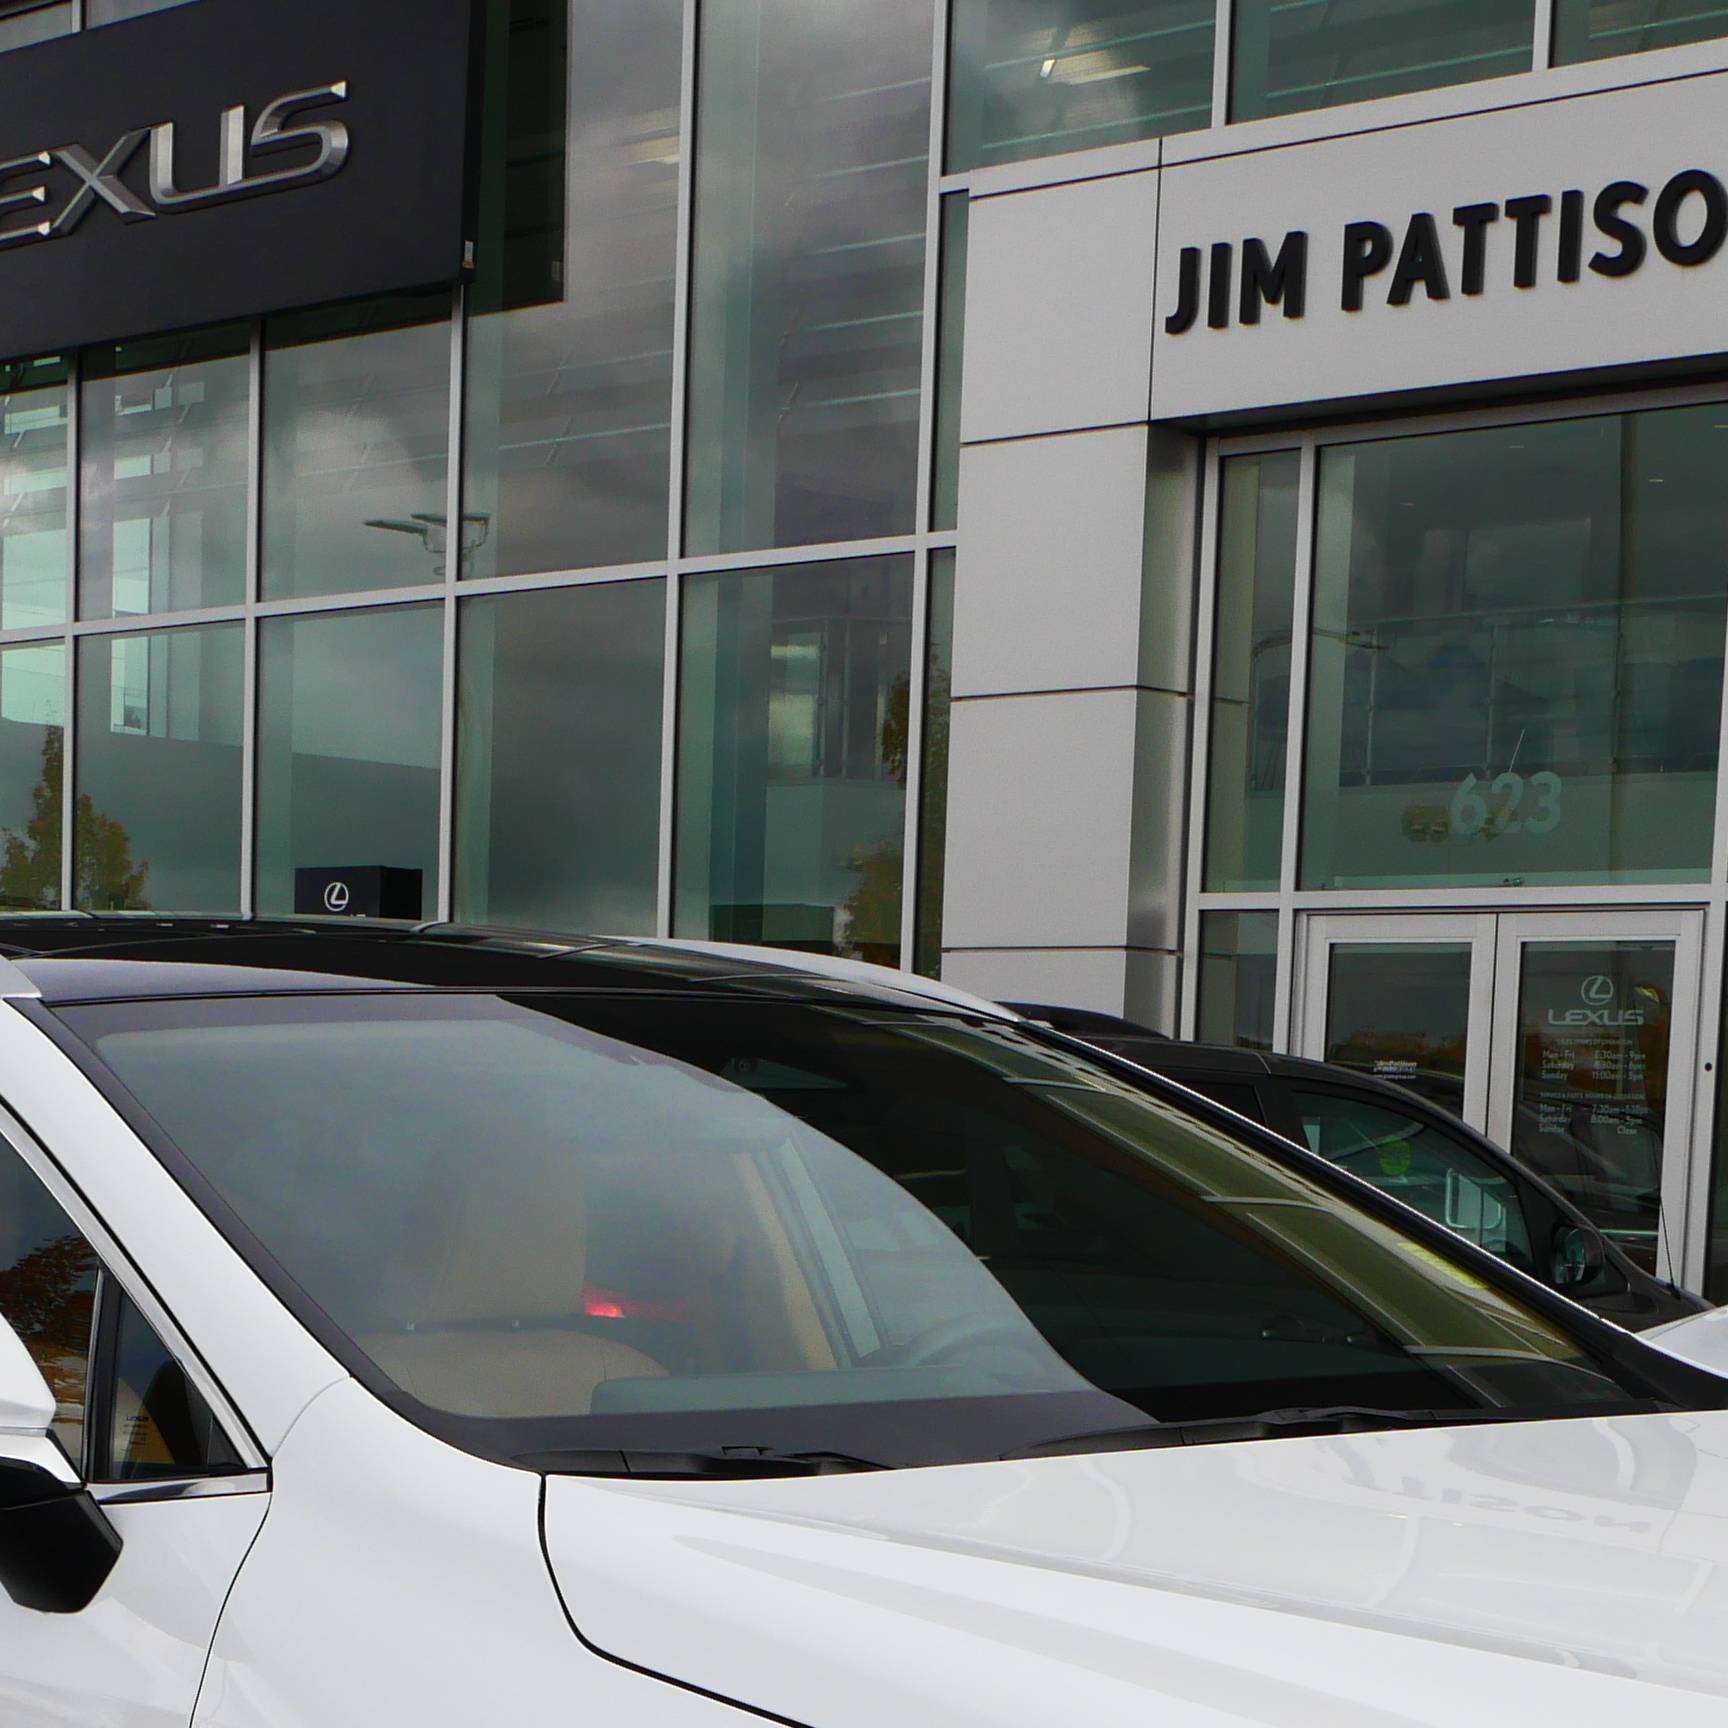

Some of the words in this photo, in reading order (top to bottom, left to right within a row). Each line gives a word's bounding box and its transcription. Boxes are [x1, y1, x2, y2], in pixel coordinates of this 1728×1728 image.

[1165, 231, 1307, 336] JIM
[1449, 771, 1562, 836] 623
[1548, 1008, 1645, 1025] LEXUS
